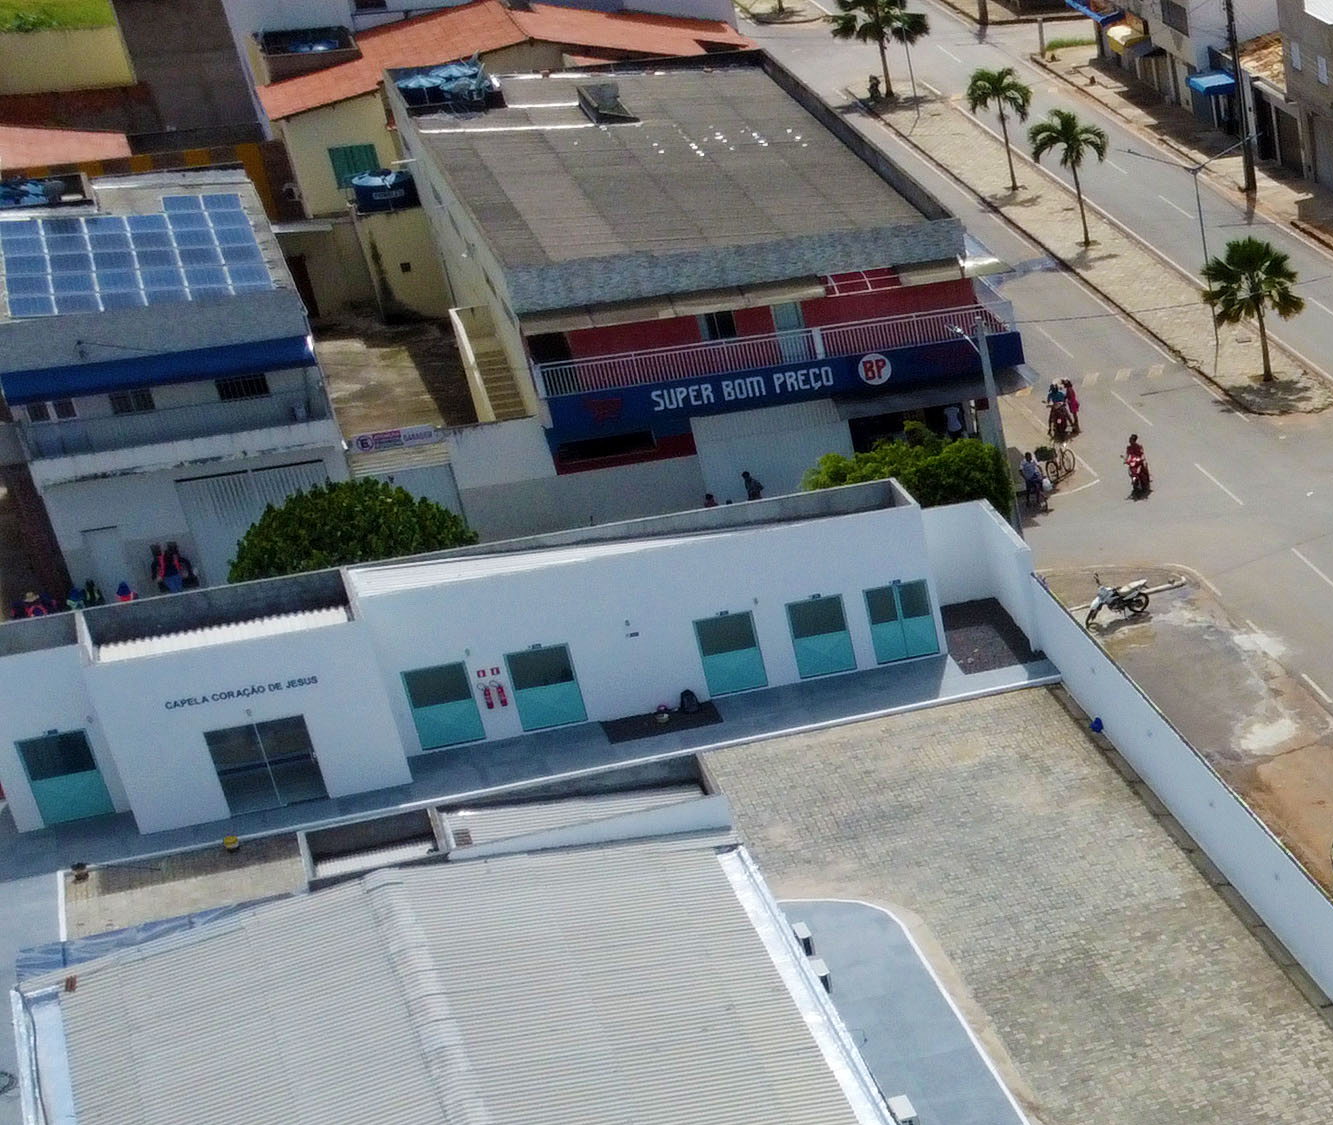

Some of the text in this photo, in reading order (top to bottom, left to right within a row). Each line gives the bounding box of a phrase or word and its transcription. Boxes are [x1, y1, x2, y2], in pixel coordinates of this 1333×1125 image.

[863, 358, 886, 380] BP
[651, 366, 834, 411] SUPER BOM PREÇO
[165, 675, 318, 710] CAPELA CORAÇÃO DE JESUS
